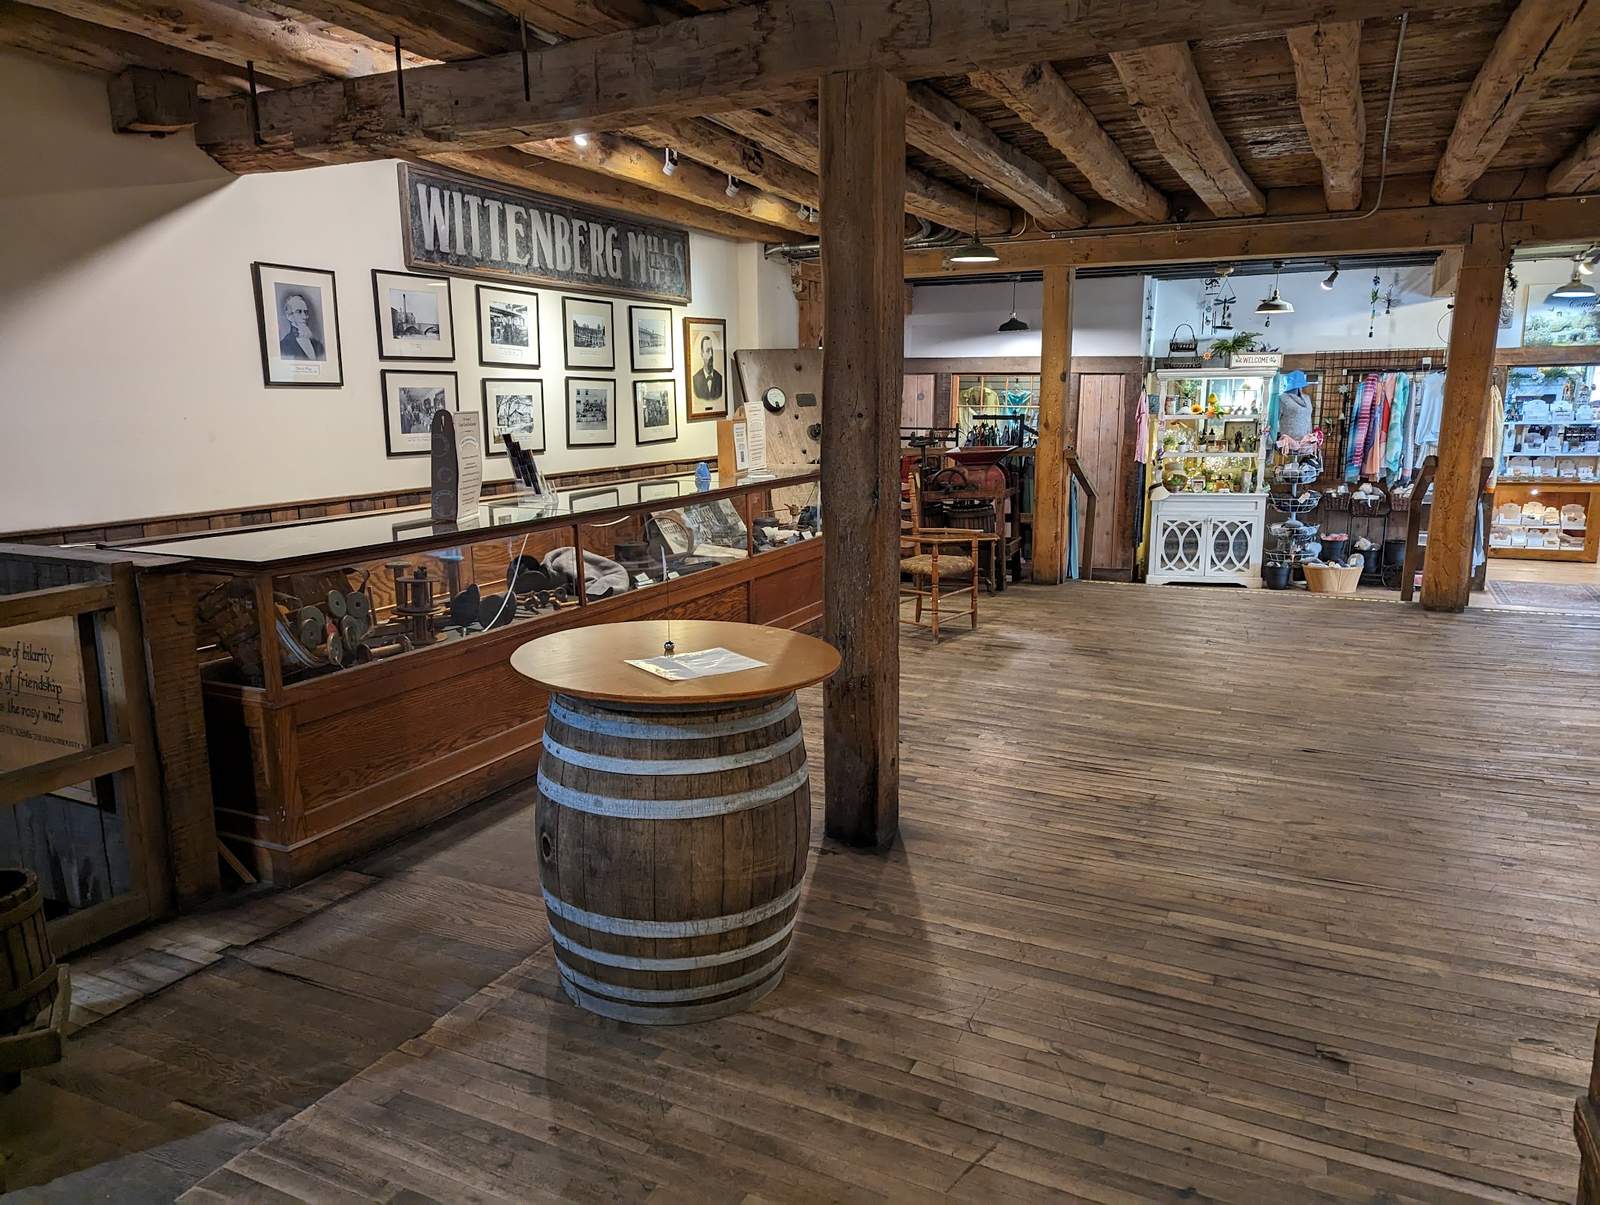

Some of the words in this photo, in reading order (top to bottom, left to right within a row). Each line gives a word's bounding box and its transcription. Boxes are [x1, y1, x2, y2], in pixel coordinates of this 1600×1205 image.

[416, 183, 622, 281] WITTENBERG
[1242, 355, 1269, 364] WELCOME
[12, 641, 20, 668] of
[22, 643, 54, 672] hilarity
[15, 670, 63, 704] friendship
[8, 698, 20, 714] the
